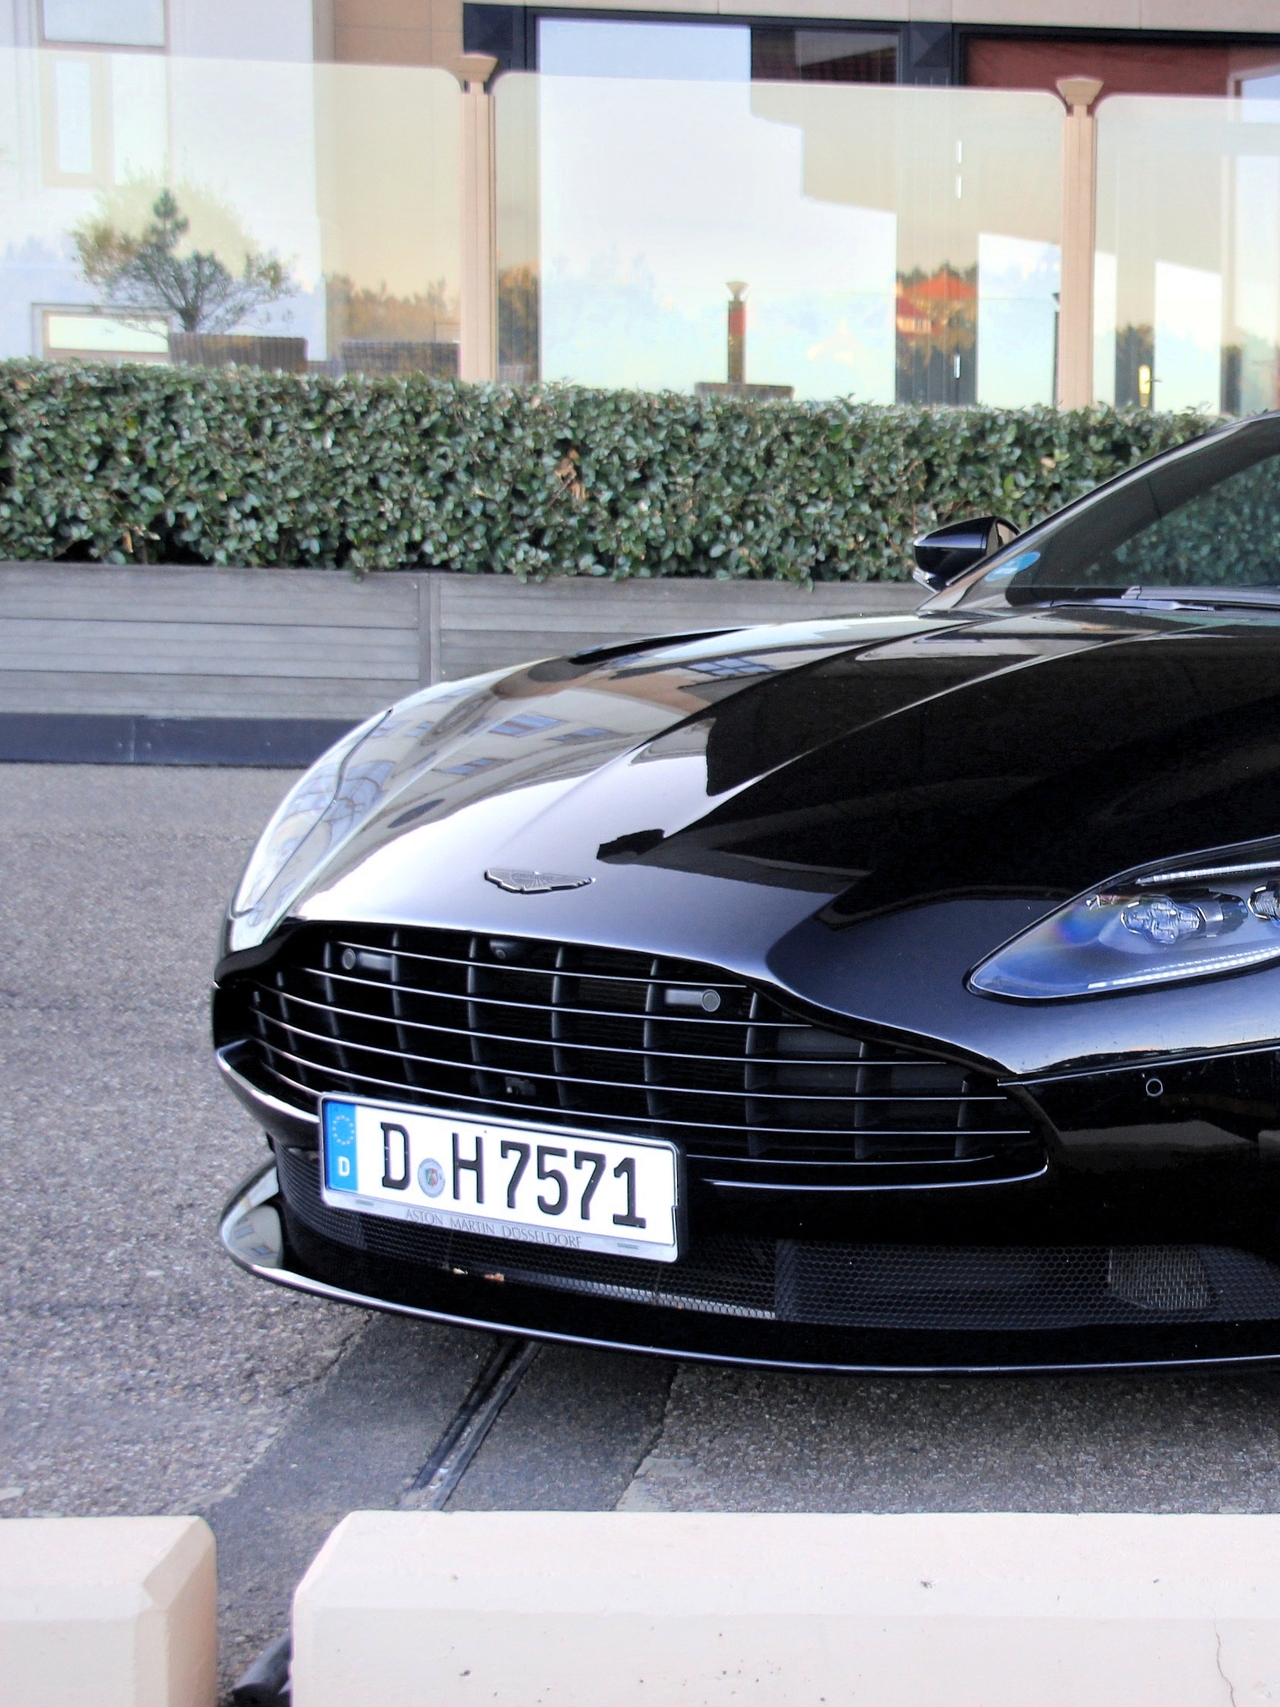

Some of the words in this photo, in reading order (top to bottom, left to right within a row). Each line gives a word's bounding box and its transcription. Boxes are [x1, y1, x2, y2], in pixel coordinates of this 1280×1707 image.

[338, 1155, 351, 1177] D
[380, 1121, 410, 1191] D
[406, 1208, 444, 1226] ASTON
[450, 1217, 496, 1236] MARTIN
[501, 1225, 583, 1248] DÜSSELDORF
